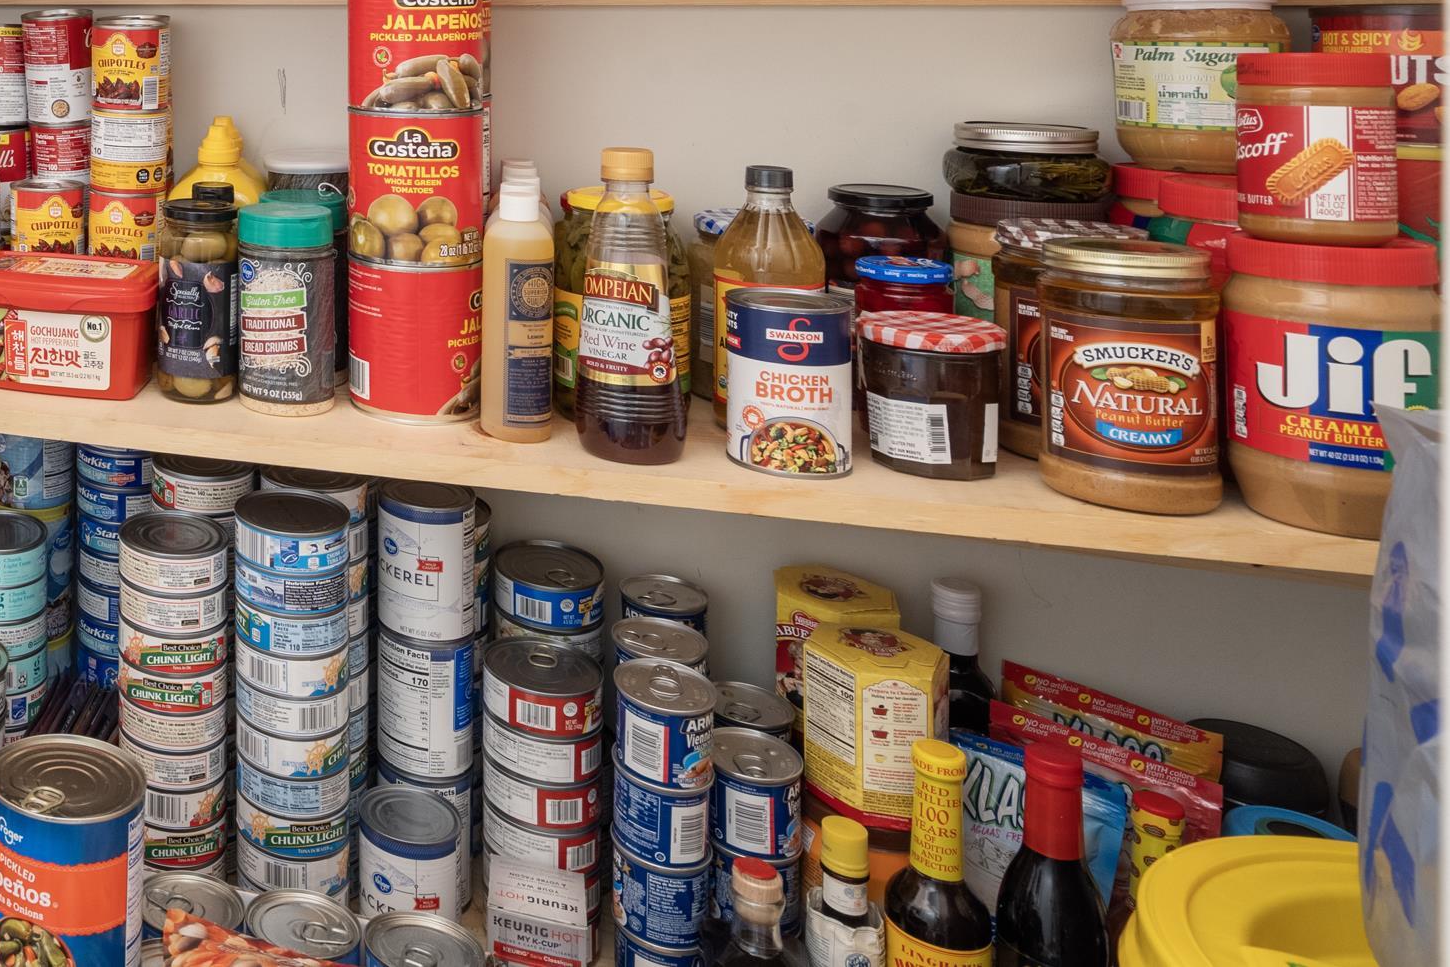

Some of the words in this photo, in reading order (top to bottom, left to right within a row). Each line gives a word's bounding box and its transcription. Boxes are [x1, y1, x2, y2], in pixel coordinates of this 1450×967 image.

[382, 11, 482, 30] JALAPEÑOS
[370, 33, 412, 42] PICKLED
[415, 31, 467, 42] JALAPEÑO
[1323, 32, 1339, 46] HOT
[1340, 33, 1349, 45] &
[1352, 32, 1392, 47] SPICY
[98, 58, 146, 70] CHIPOTLES
[1133, 48, 1175, 64] Palm
[1183, 48, 1238, 65] Sugar
[404, 132, 422, 143] La
[1238, 132, 1288, 160] iscoff
[373, 141, 452, 158] Costeña
[367, 162, 459, 179] TOMATILLOS
[384, 178, 411, 186] WHOLE
[413, 178, 442, 186] GREEN
[391, 185, 434, 194] TOMATOES
[1248, 194, 1273, 206] BUTTER
[31, 220, 79, 231] CHIPOTLES
[245, 317, 298, 330] TRADITIONAL
[581, 304, 650, 331] ORGANIC
[30, 325, 79, 339] GOCHUJANG
[769, 330, 821, 343] SWANSON
[11, 330, 26, 371] 해찬들
[244, 341, 263, 353] BREAD
[264, 339, 298, 352] CRUMBS
[583, 333, 601, 348] Red
[603, 334, 637, 352] Wine
[30, 347, 81, 368] 진한맛
[588, 348, 628, 361] VINEGAR
[1082, 346, 1194, 371] SMUCKER'S
[83, 359, 104, 370] 고추장
[759, 370, 829, 386] CHICKEN
[1256, 331, 1432, 416] Jif
[755, 381, 833, 403] BROTH
[1071, 379, 1203, 417] NATURAL
[1095, 409, 1142, 425] Peanut
[1145, 415, 1184, 428] Butter
[1285, 415, 1374, 437] CREAMY
[1108, 428, 1172, 445] CREAMY
[1280, 424, 1330, 442] PEANUT
[1334, 433, 1385, 448] BUTTER
[380, 558, 435, 587] CKEREL
[147, 654, 182, 665] CHUNK
[184, 652, 211, 663] LIGHT
[411, 675, 429, 688] 170
[131, 687, 162, 701] CHUNK
[165, 692, 195, 703] LIGHT
[1092, 698, 1106, 707] NO
[1106, 702, 1136, 716] artificial
[1082, 741, 1098, 751] NO
[1098, 745, 1129, 759] artificial
[921, 781, 949, 796] RED
[919, 802, 949, 825] 100
[270, 834, 313, 846] CHUNK
[315, 826, 345, 842] LIGHT
[915, 817, 958, 839] YEARS
[921, 849, 943, 862] AND
[0, 853, 36, 883] PICKLED
[493, 915, 549, 938] KEURIG
[551, 930, 584, 944] HOT
